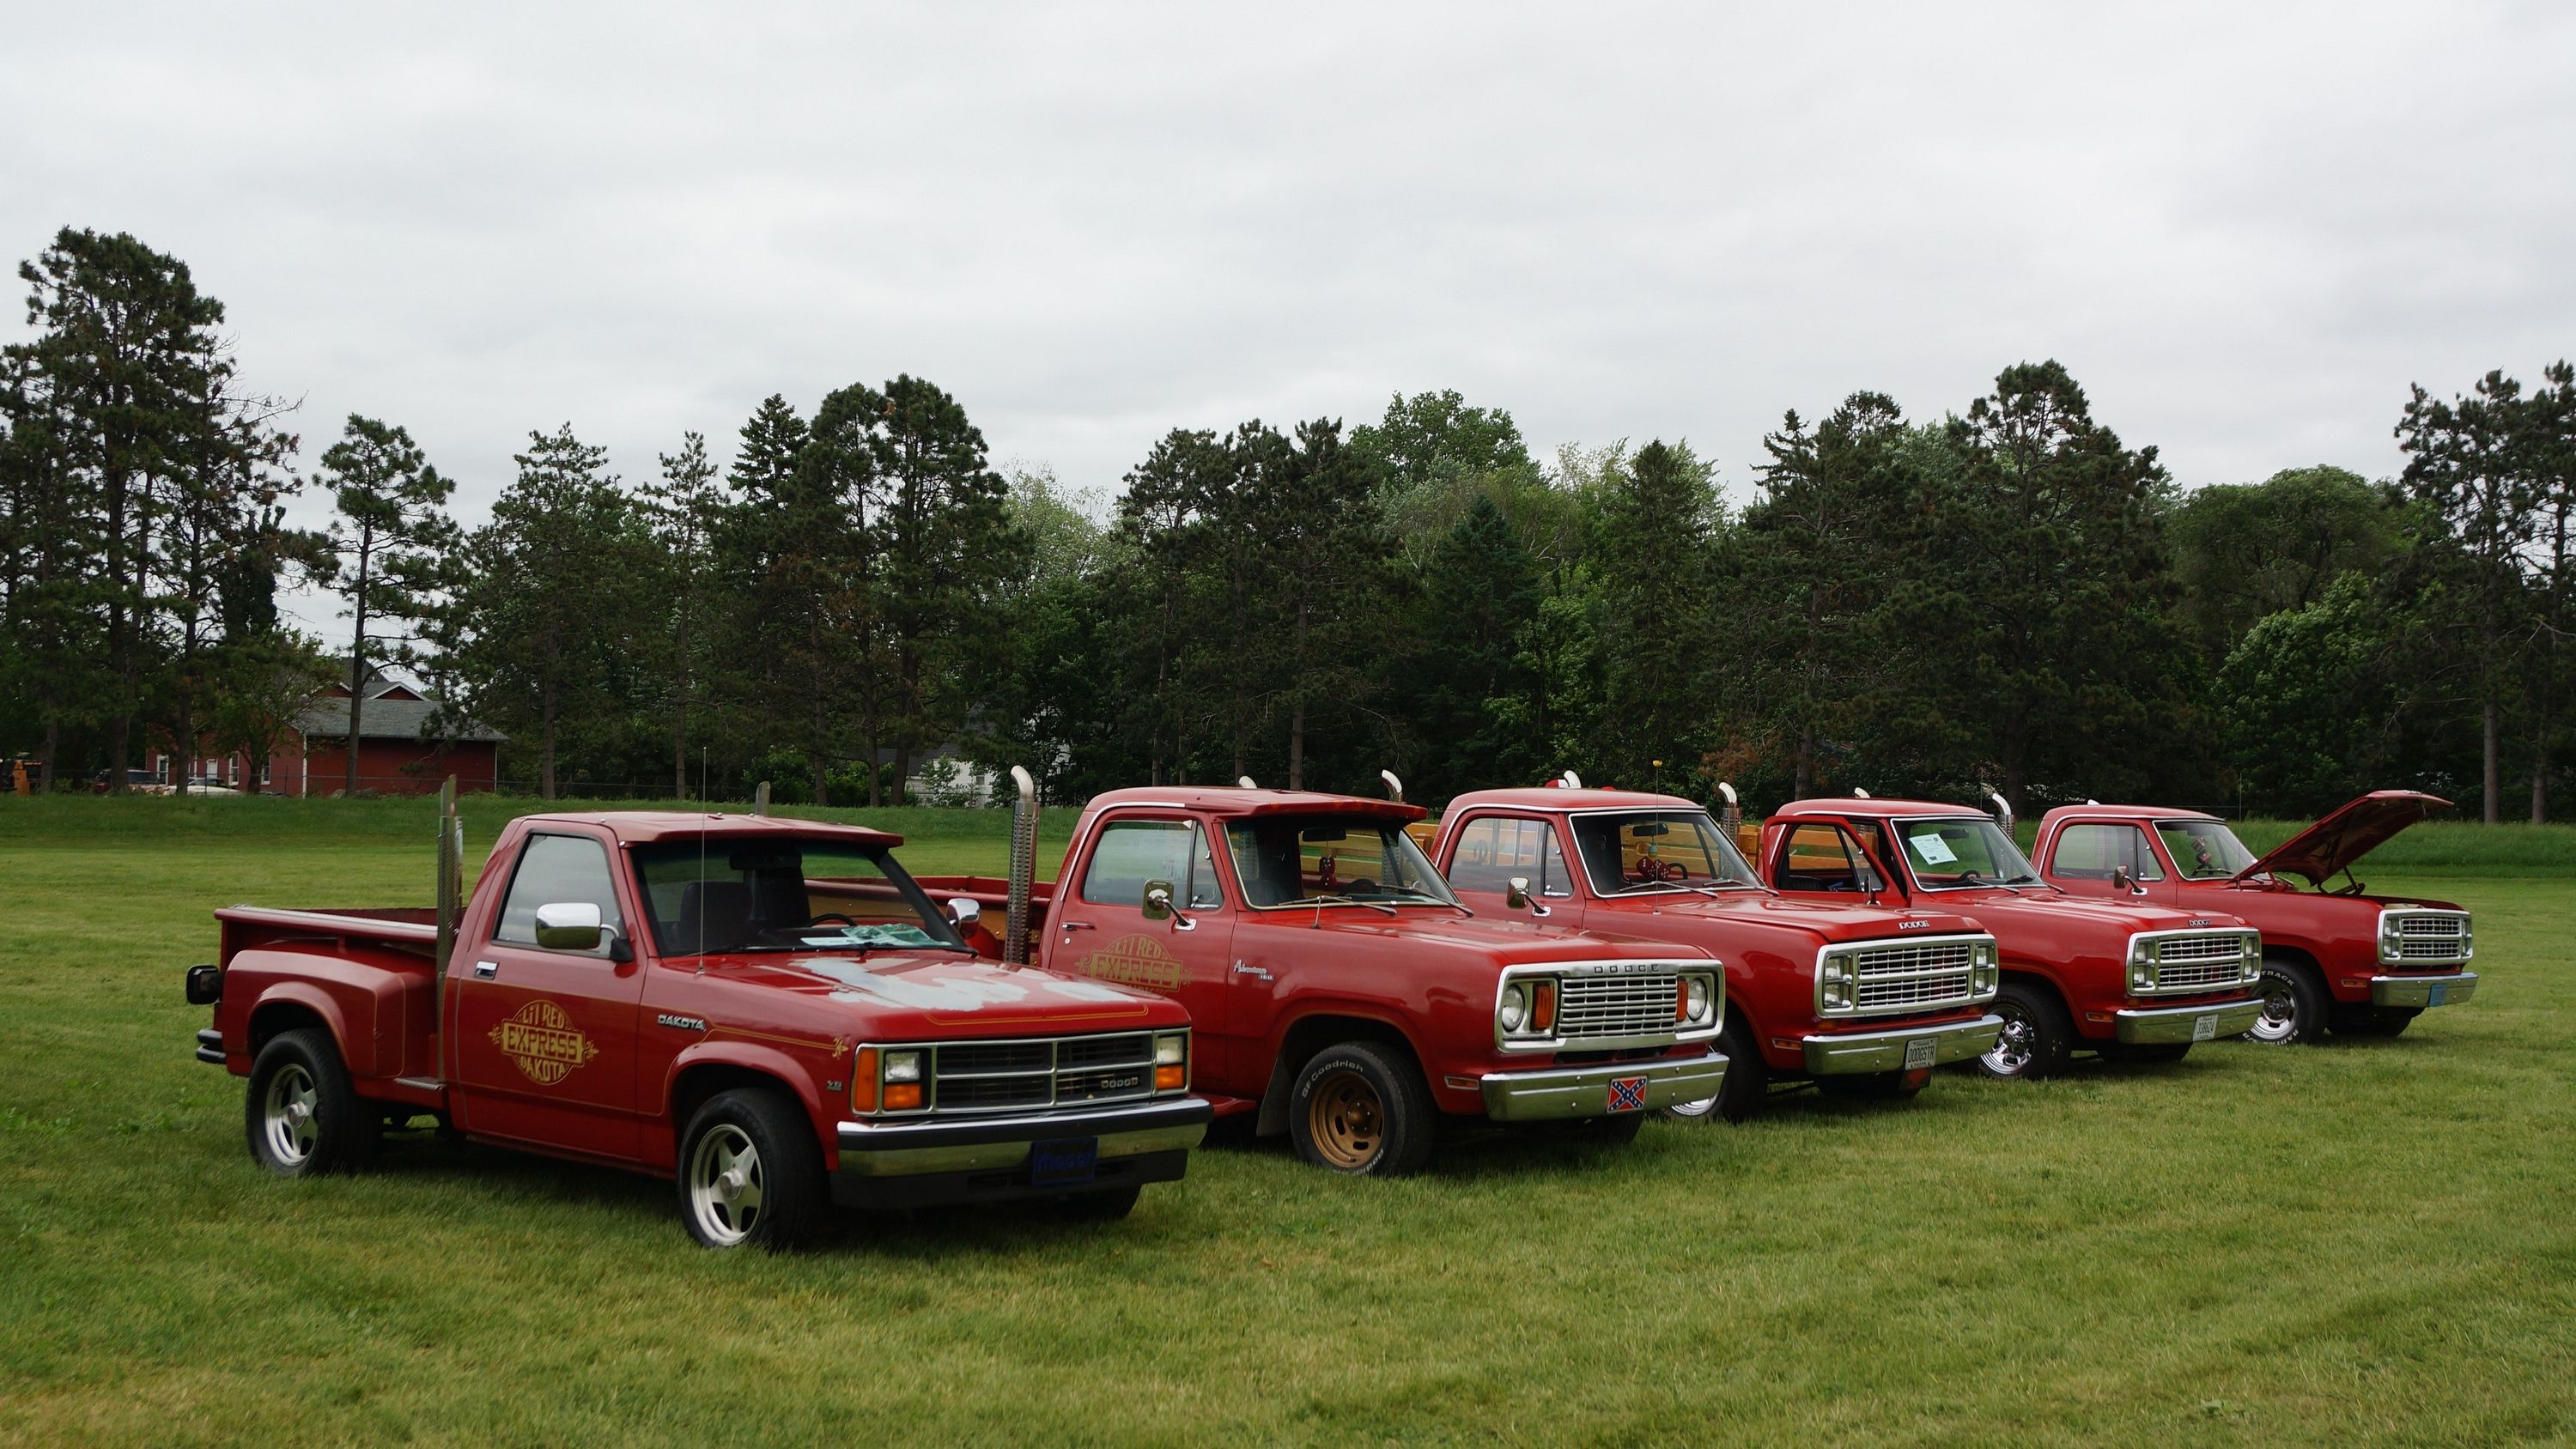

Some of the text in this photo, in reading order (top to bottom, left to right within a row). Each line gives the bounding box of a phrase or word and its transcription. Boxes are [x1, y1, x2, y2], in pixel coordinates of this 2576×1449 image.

[1899, 919, 1929, 930] DODGE
[1137, 937, 1162, 960] RED
[1098, 955, 1175, 986] EXPRESS
[1594, 963, 1660, 974] DODGE
[543, 1003, 566, 1029] RED
[657, 1014, 707, 1032] DAKOTA
[507, 1025, 578, 1061] EXPRESS
[518, 1055, 568, 1082] DAKOTA
